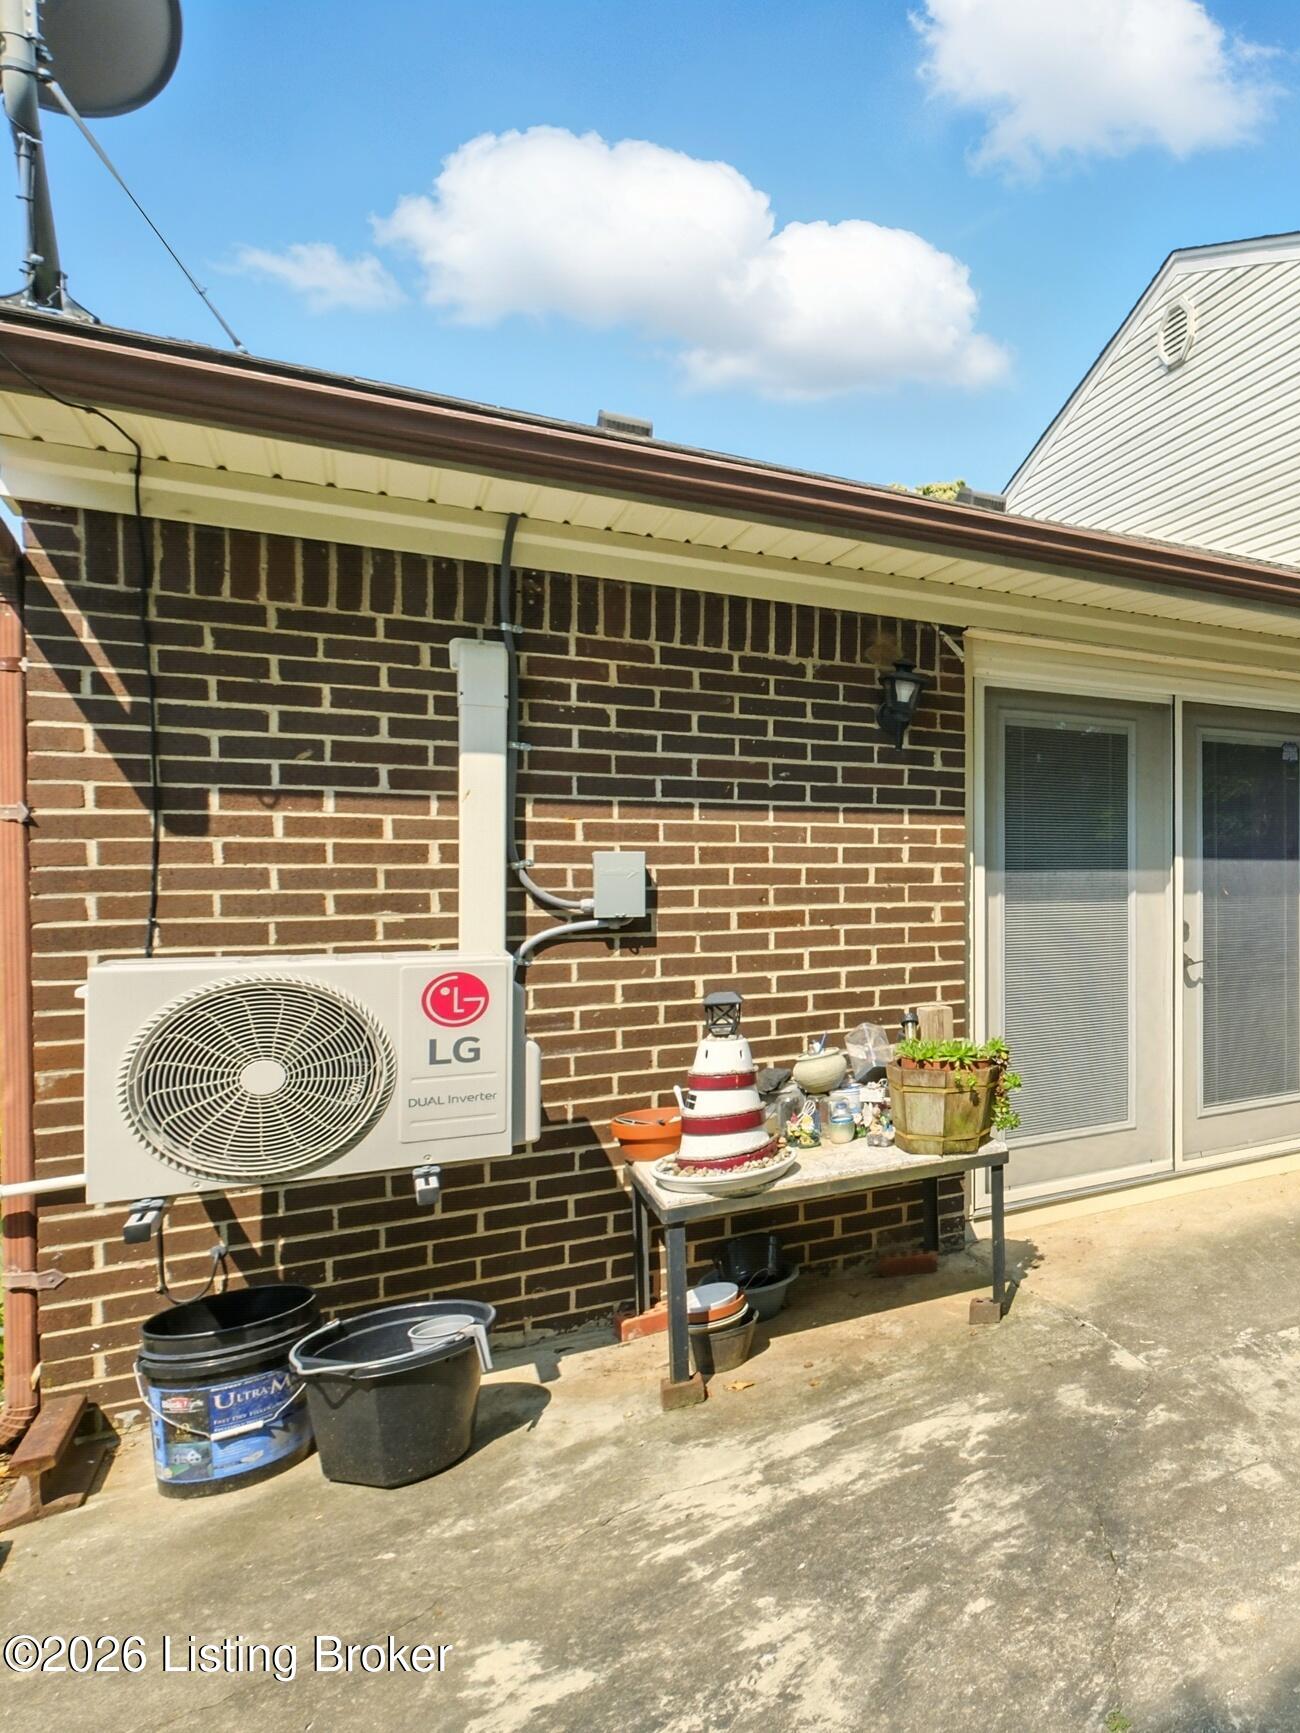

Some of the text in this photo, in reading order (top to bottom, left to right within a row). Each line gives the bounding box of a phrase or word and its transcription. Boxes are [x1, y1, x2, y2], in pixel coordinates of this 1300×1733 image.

[429, 1036, 481, 1065] LG
[408, 1092, 497, 1108] DUAL Inverter
